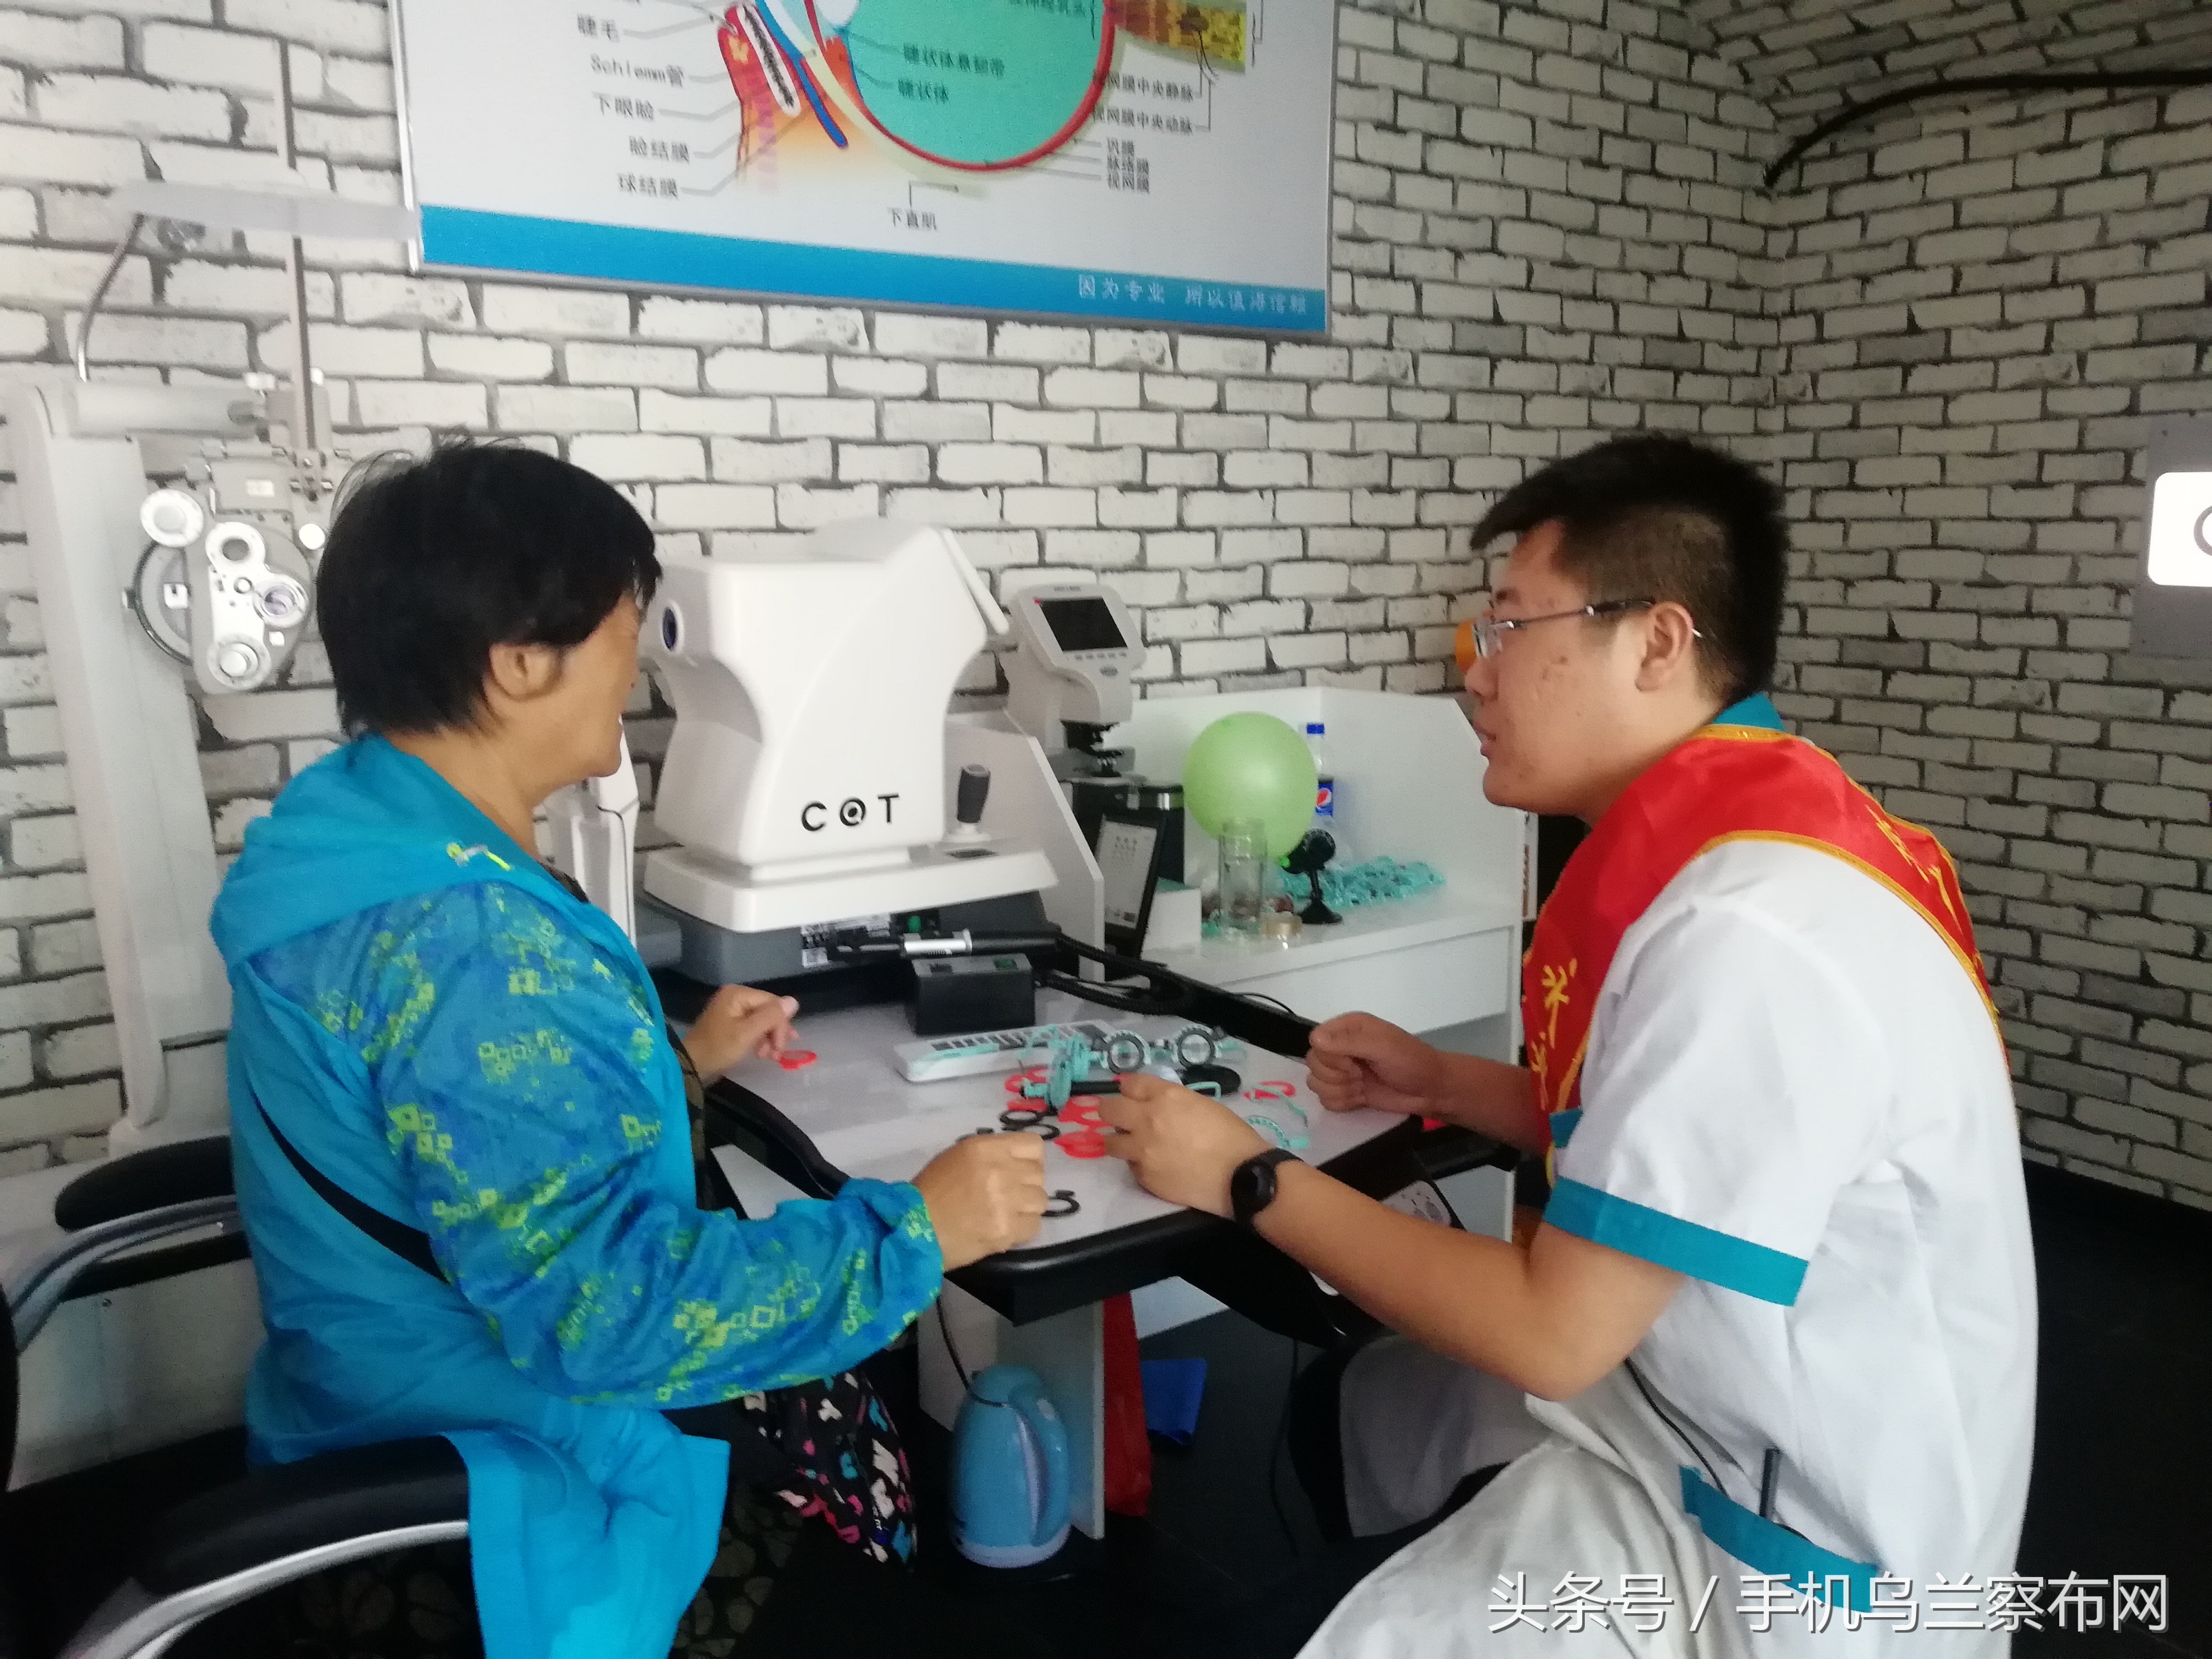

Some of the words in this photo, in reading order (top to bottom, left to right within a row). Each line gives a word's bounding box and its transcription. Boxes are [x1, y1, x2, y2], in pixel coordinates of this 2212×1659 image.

[887, 207, 939, 232] 下直肌
[1079, 274, 1165, 304] 因为专业
